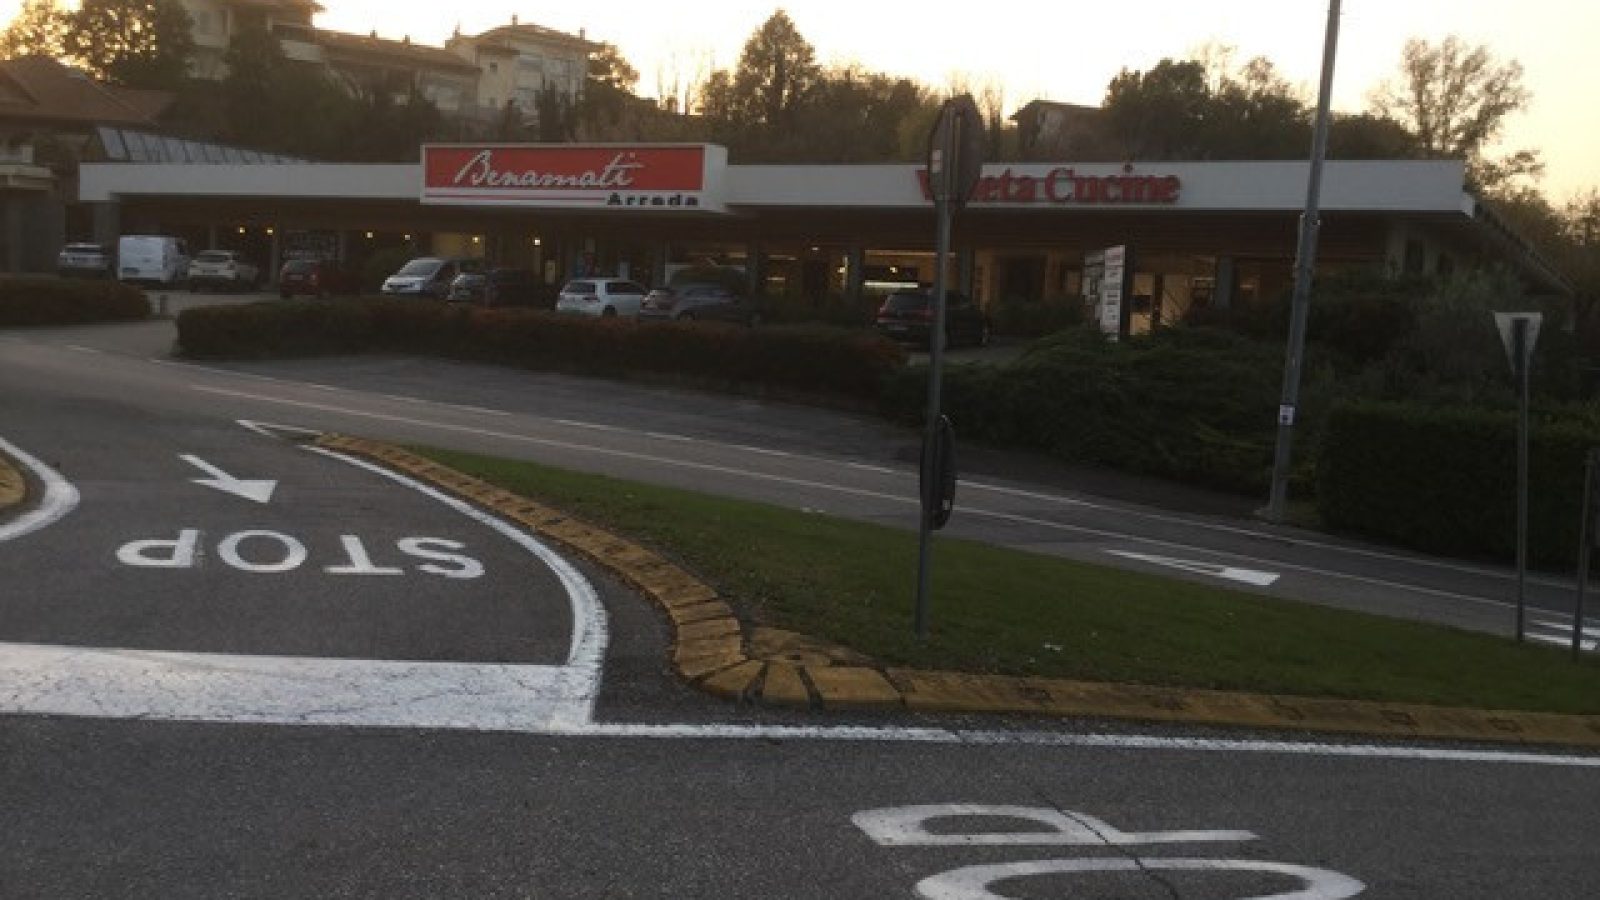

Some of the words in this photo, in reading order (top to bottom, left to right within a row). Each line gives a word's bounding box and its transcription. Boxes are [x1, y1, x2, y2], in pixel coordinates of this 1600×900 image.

[454, 149, 644, 187] Benamati
[915, 167, 1034, 202] Veta
[1044, 162, 1182, 202] Cucine
[115, 528, 486, 579] STOP
